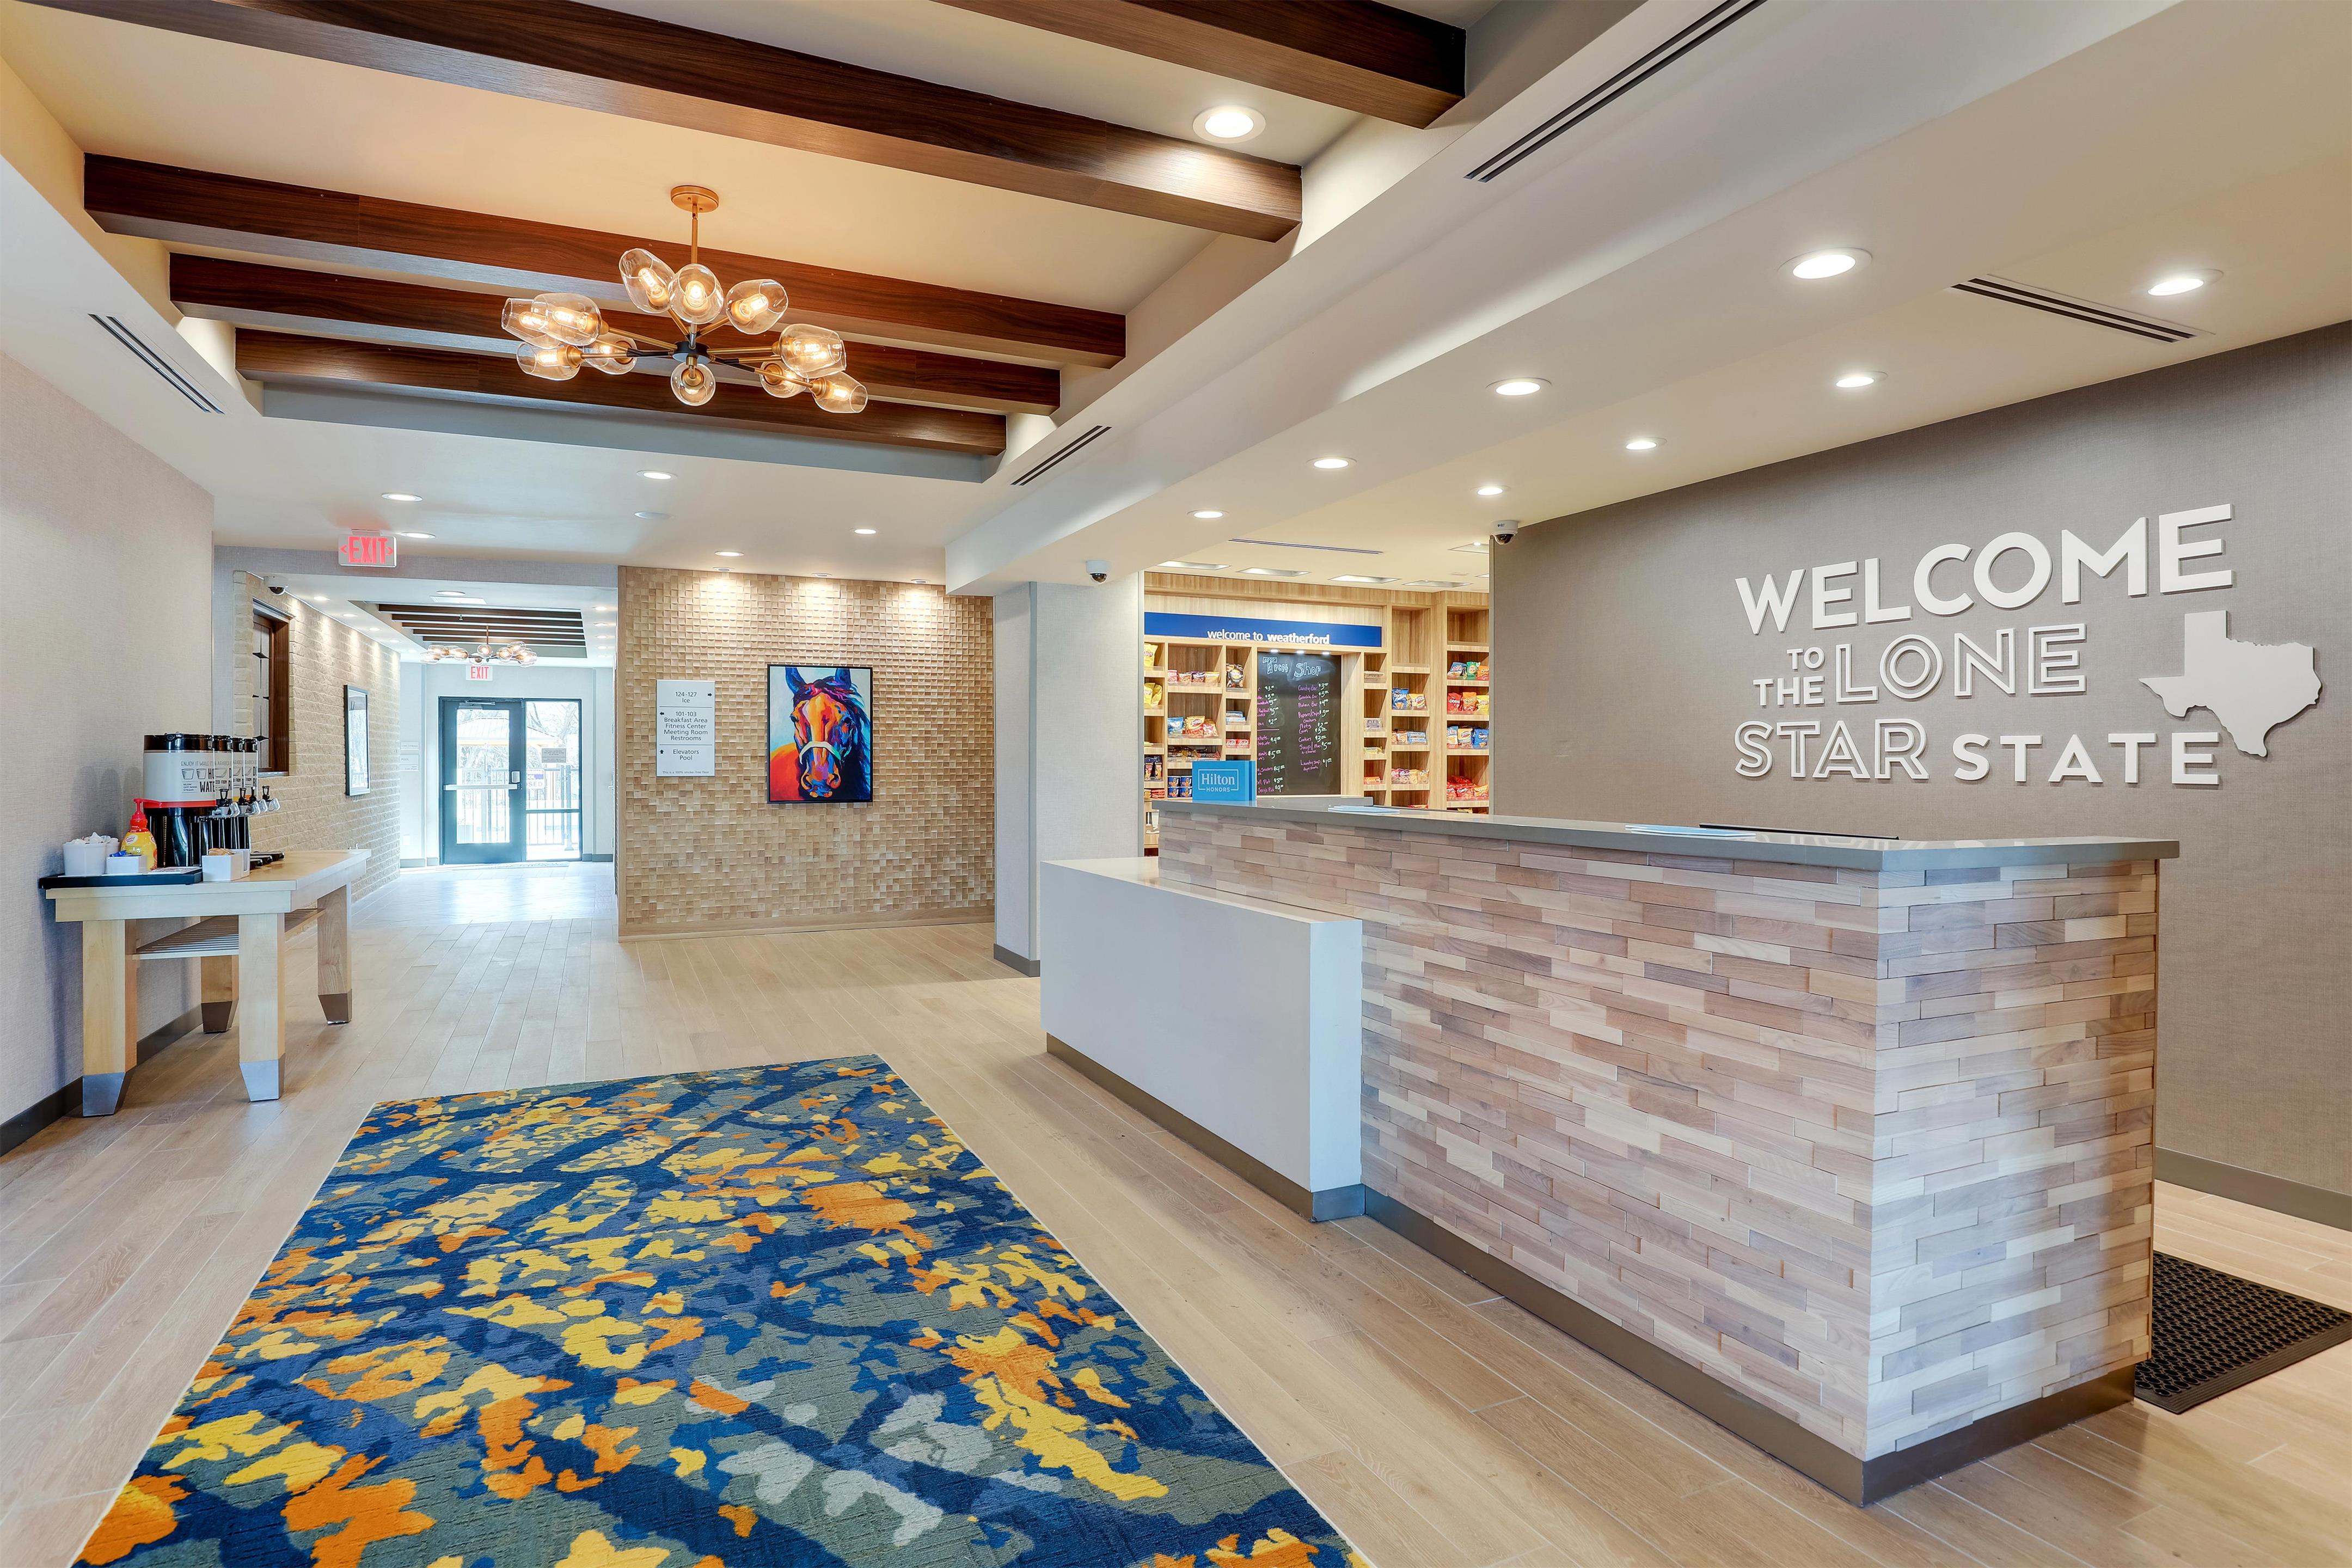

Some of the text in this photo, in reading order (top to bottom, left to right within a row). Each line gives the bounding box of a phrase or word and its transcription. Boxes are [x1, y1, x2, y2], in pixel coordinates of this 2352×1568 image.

[348, 536, 388, 564] EXIT
[1735, 503, 2234, 635] WELCOME
[1206, 629, 1330, 645] welcome to weatherford
[1787, 646, 1826, 671] TO
[1836, 623, 2087, 705] LONE
[471, 666, 489, 679] EXIT
[1753, 675, 1826, 707] THE
[1735, 718, 2221, 786] STAR STATE
[200, 781, 215, 792] WATE
[1202, 773, 1235, 785] Hilton
